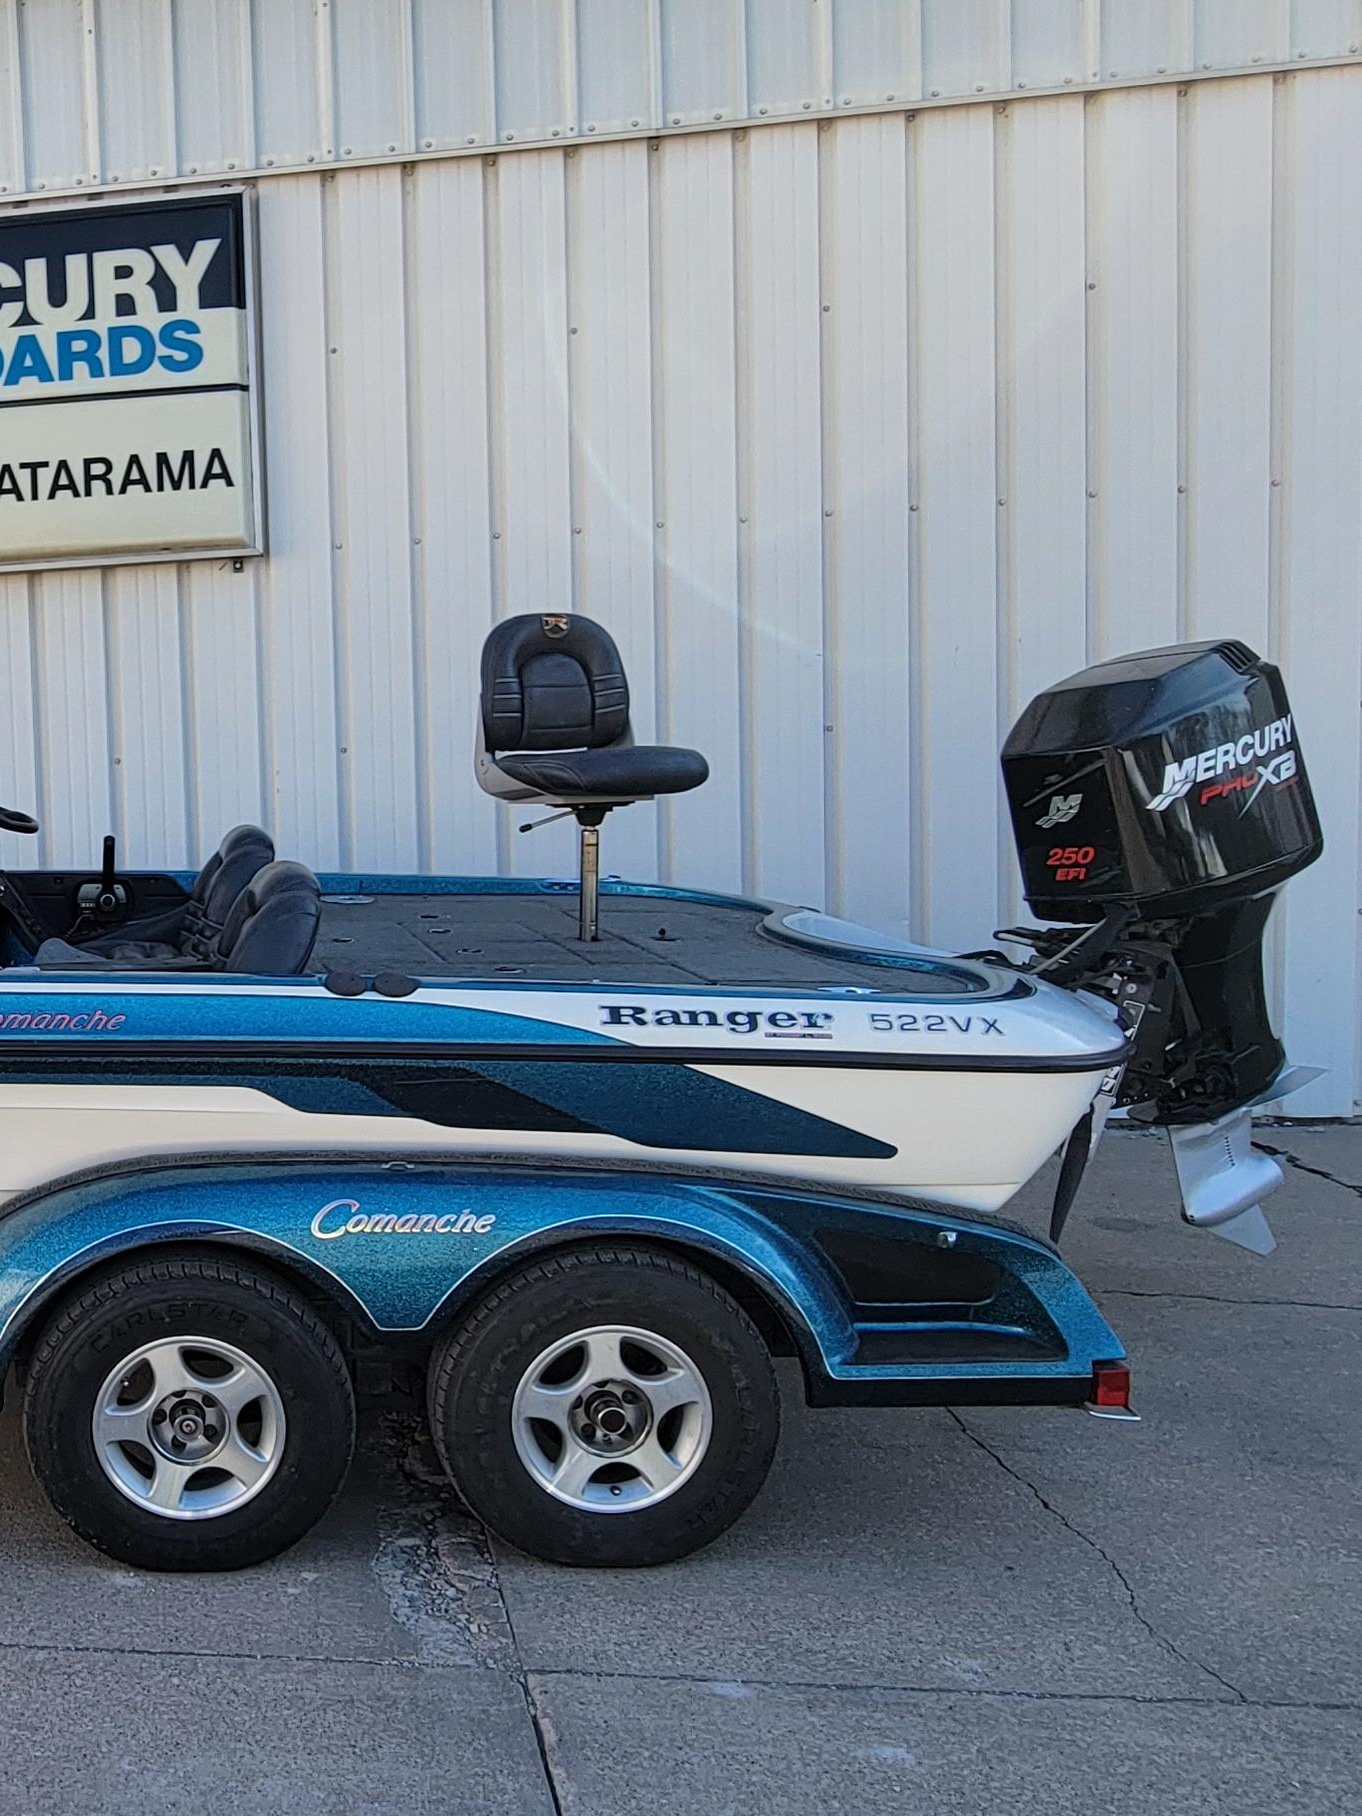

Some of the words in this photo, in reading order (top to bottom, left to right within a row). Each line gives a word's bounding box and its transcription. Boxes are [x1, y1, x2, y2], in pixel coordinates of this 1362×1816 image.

[1146, 714, 1292, 812] MERCURY
[1046, 846, 1095, 866] 250
[1055, 868, 1087, 881] EFI
[599, 1004, 835, 1034] Ranger
[869, 1013, 1005, 1036] 522VX
[310, 1199, 497, 1239] Comanche
